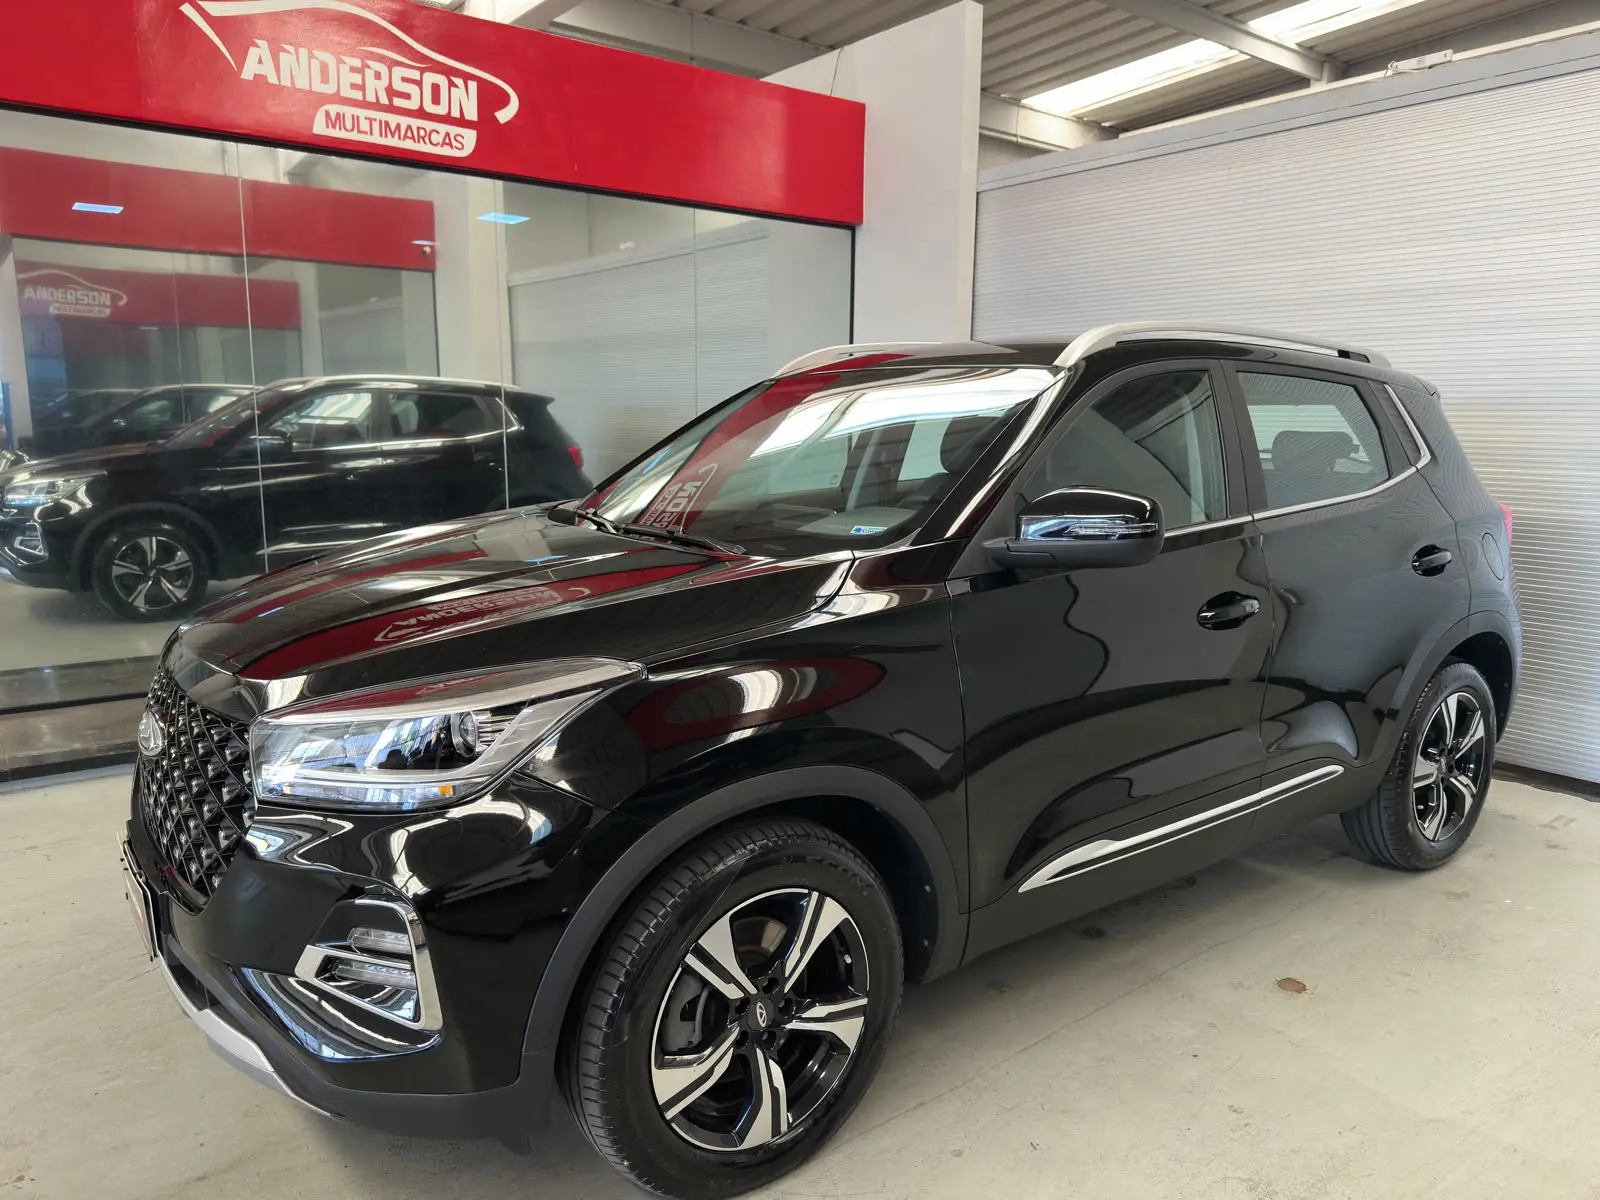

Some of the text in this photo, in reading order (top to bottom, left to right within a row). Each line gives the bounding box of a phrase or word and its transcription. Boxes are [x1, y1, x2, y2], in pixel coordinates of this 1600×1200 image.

[240, 39, 479, 122] ANDERSON
[324, 109, 465, 151] MULTIMARCAS
[23, 285, 111, 306] ANDERSON
